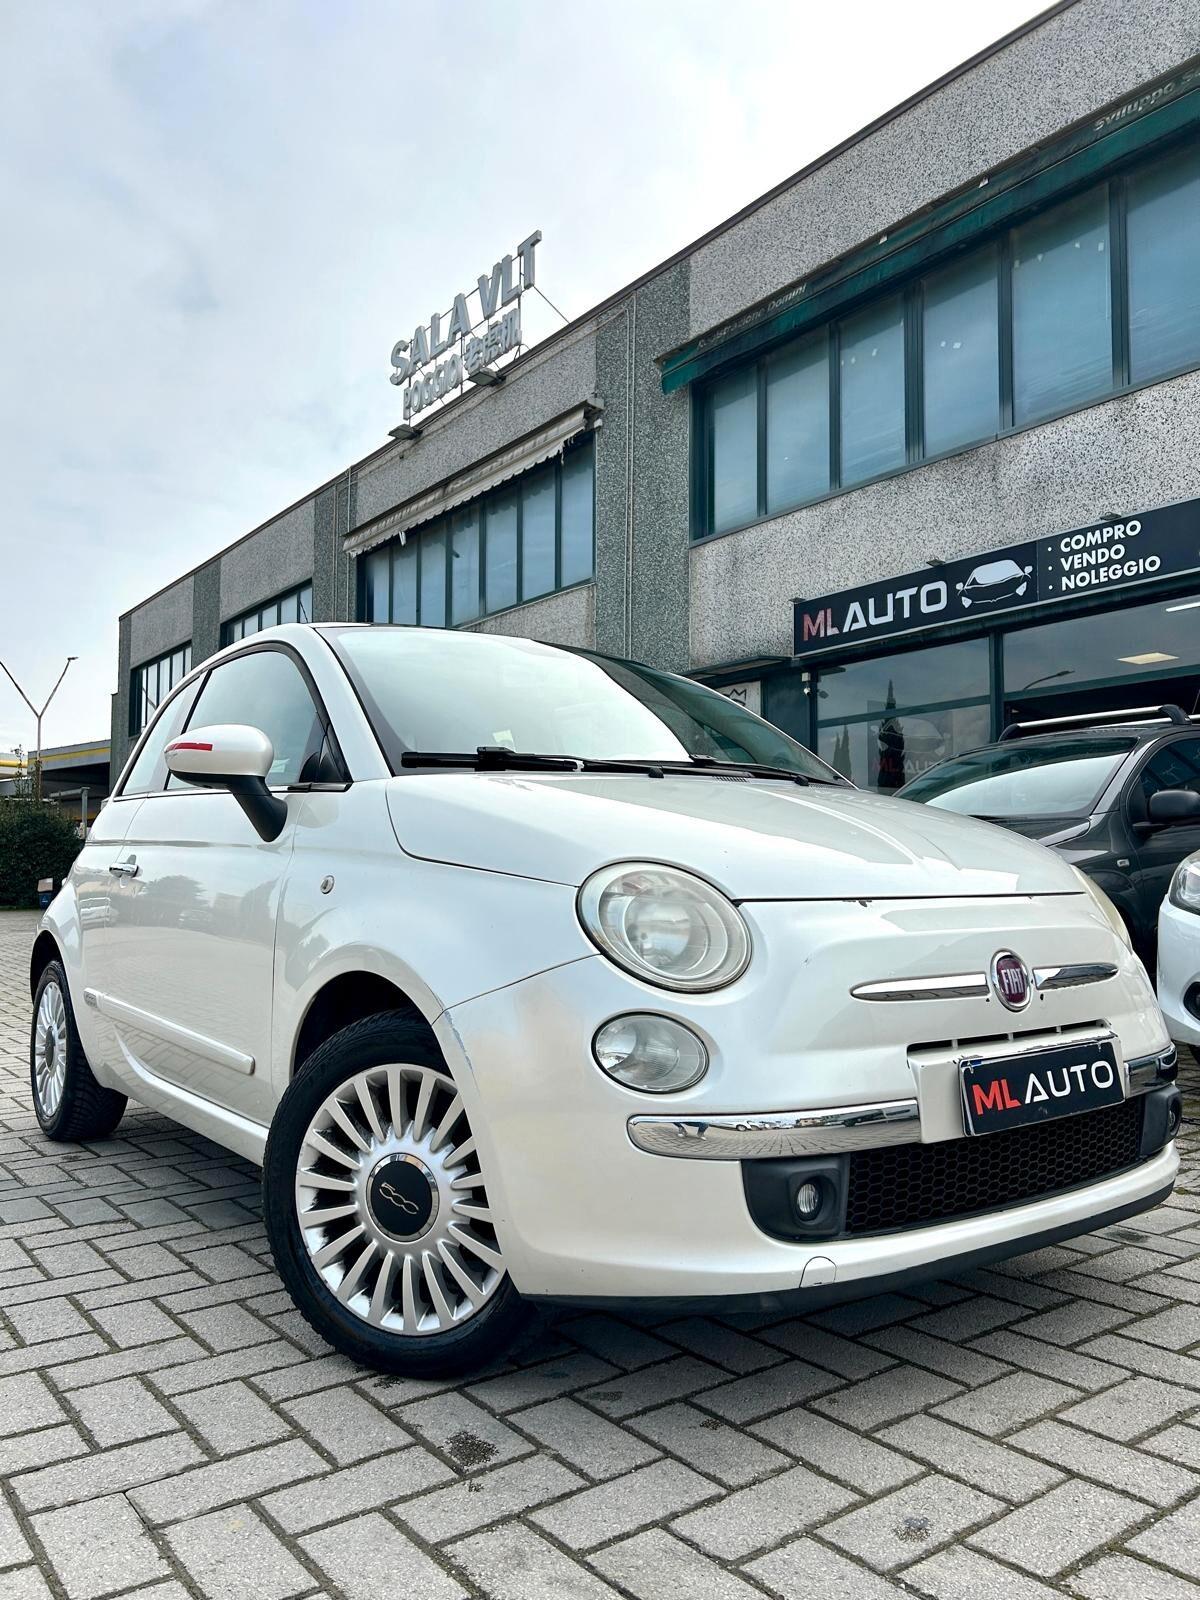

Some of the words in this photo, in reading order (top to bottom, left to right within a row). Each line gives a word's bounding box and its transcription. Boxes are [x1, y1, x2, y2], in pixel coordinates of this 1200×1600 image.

[1094, 82, 1176, 131] Sviluppo
[390, 293, 471, 386] SALA
[477, 230, 542, 320] VLT
[403, 354, 463, 420] POGGIO
[1060, 520, 1142, 553] COMPRO
[1061, 544, 1126, 572] VENDO
[1061, 555, 1161, 592] NOLEGGIO
[803, 608, 840, 641] ML
[843, 581, 948, 633] AUTO
[1000, 967, 1024, 994] FIAT
[971, 1077, 1021, 1116] ML
[1024, 1060, 1114, 1105] AUTO
[379, 1182, 419, 1215] 500
